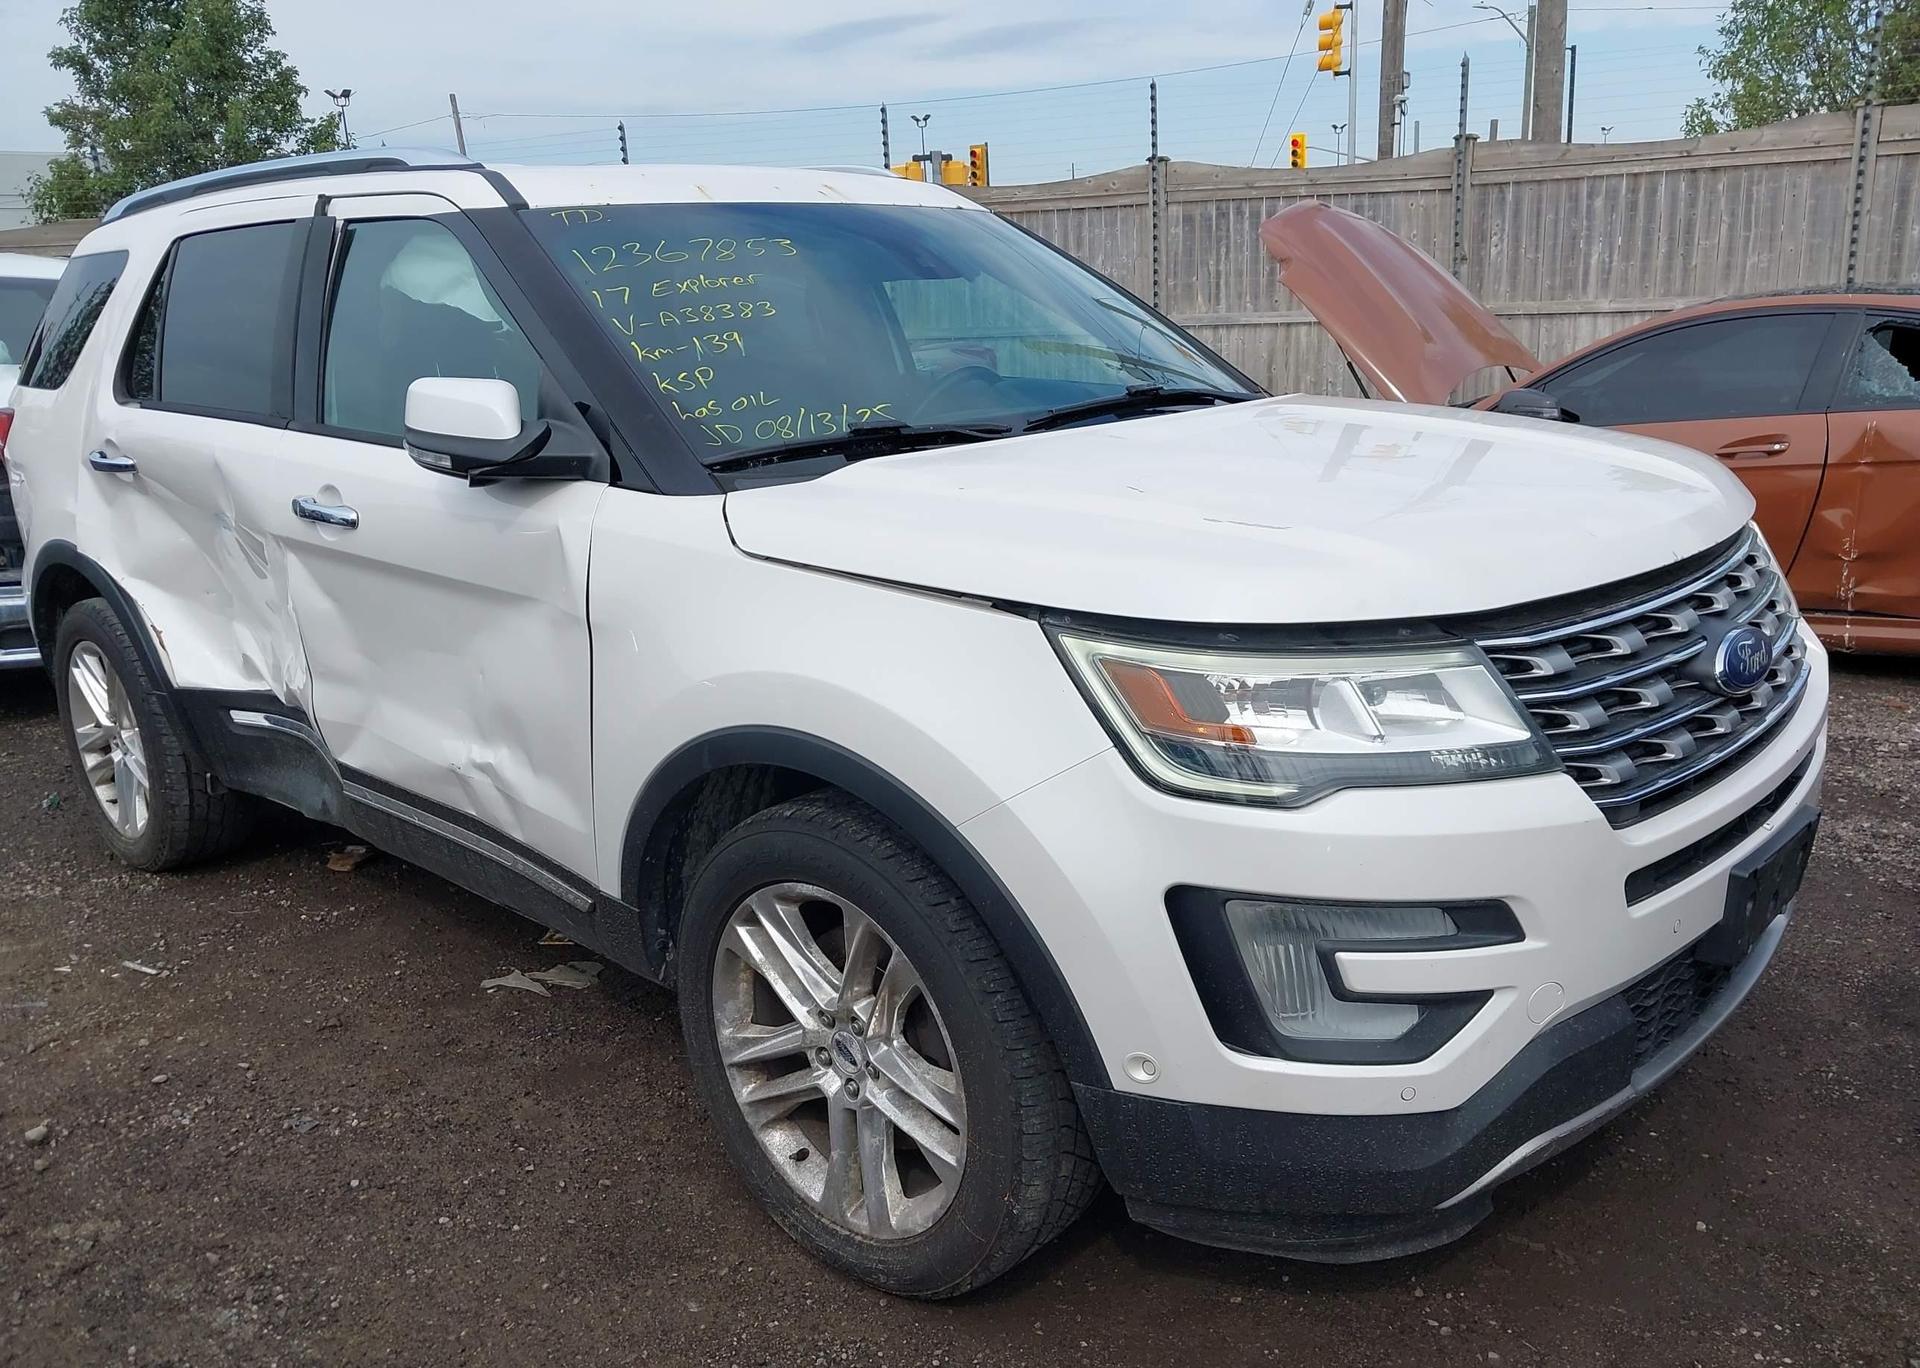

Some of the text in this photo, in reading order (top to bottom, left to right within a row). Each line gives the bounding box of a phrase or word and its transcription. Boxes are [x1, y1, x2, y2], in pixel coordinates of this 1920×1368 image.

[572, 237, 797, 276] 12367853
[592, 287, 630, 308] 17
[672, 400, 723, 421] has
[1737, 637, 1769, 677] Ford
